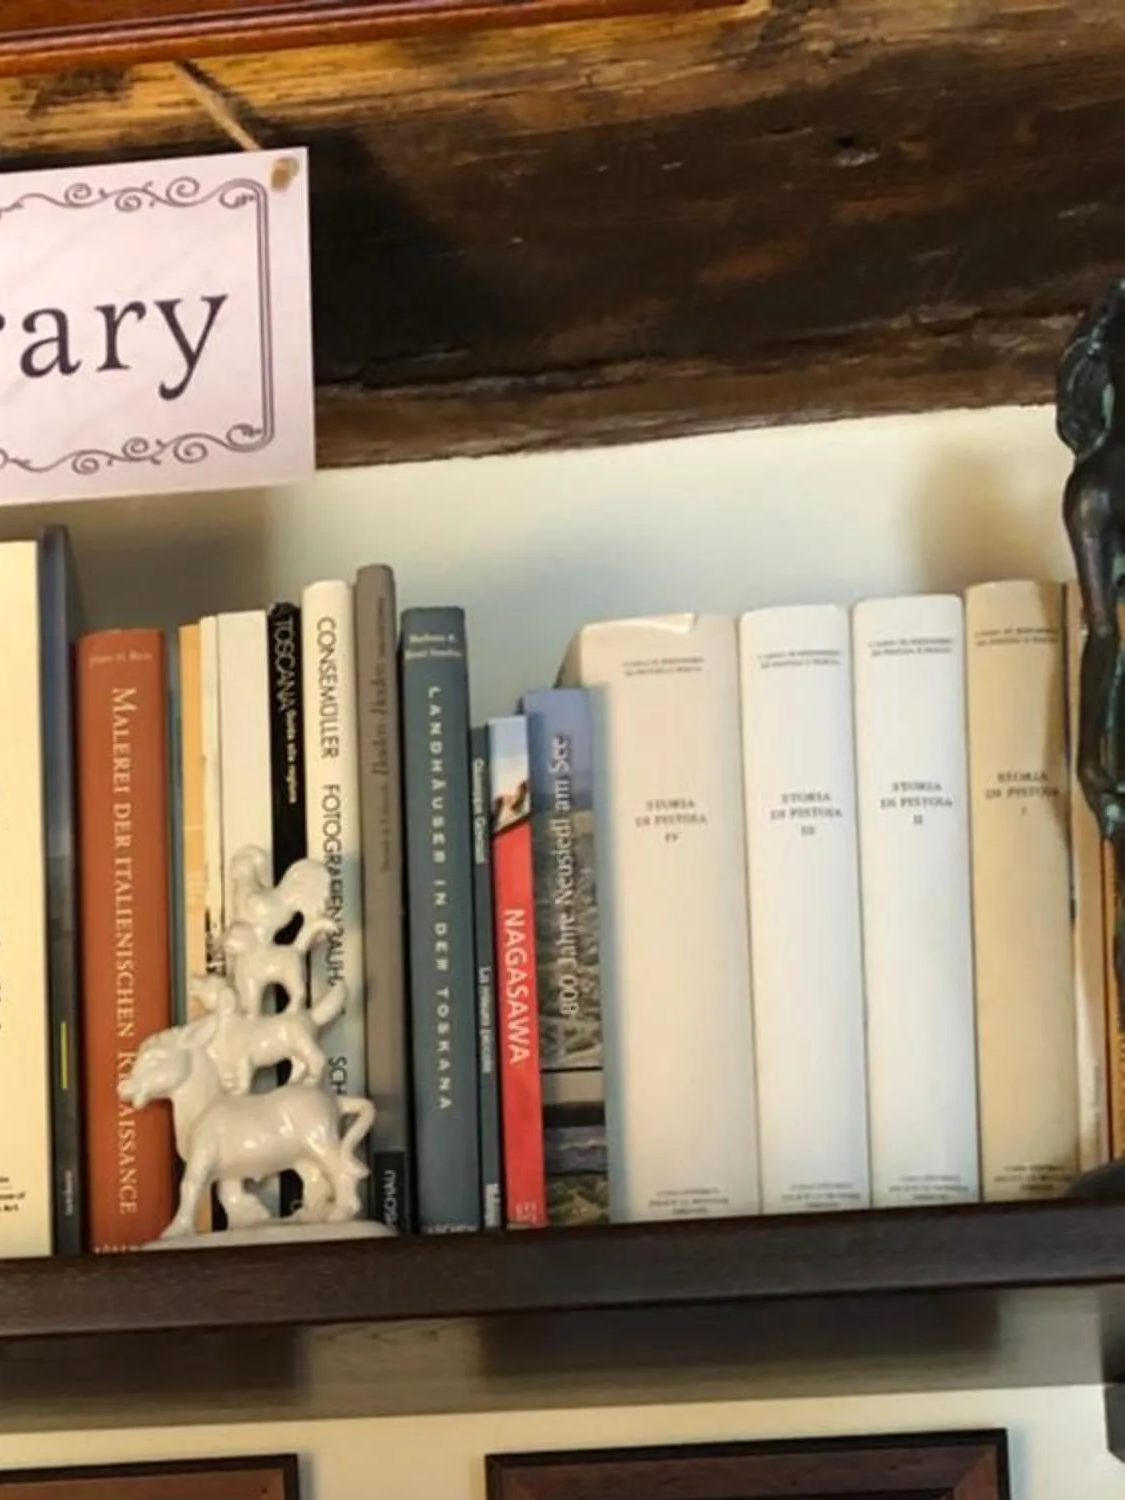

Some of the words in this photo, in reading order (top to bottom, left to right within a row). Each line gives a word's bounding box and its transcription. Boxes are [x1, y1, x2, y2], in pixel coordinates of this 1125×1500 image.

[274, 617, 297, 712] TOSCANA
[316, 616, 342, 759] CONSEMÜLLER
[112, 687, 140, 794] MALEREI
[428, 686, 448, 864] LANDHÄUSER
[548, 736, 572, 774] See
[113, 802, 133, 851] DER
[553, 780, 573, 812] am
[114, 857, 137, 1037] ITALIENISCHEN
[434, 880, 447, 907] IN
[435, 922, 449, 971] DER
[504, 909, 532, 1065] NAGASAWA
[437, 988, 452, 1110] TOSKANA
[118, 1051, 138, 1214] RAISSANCE
